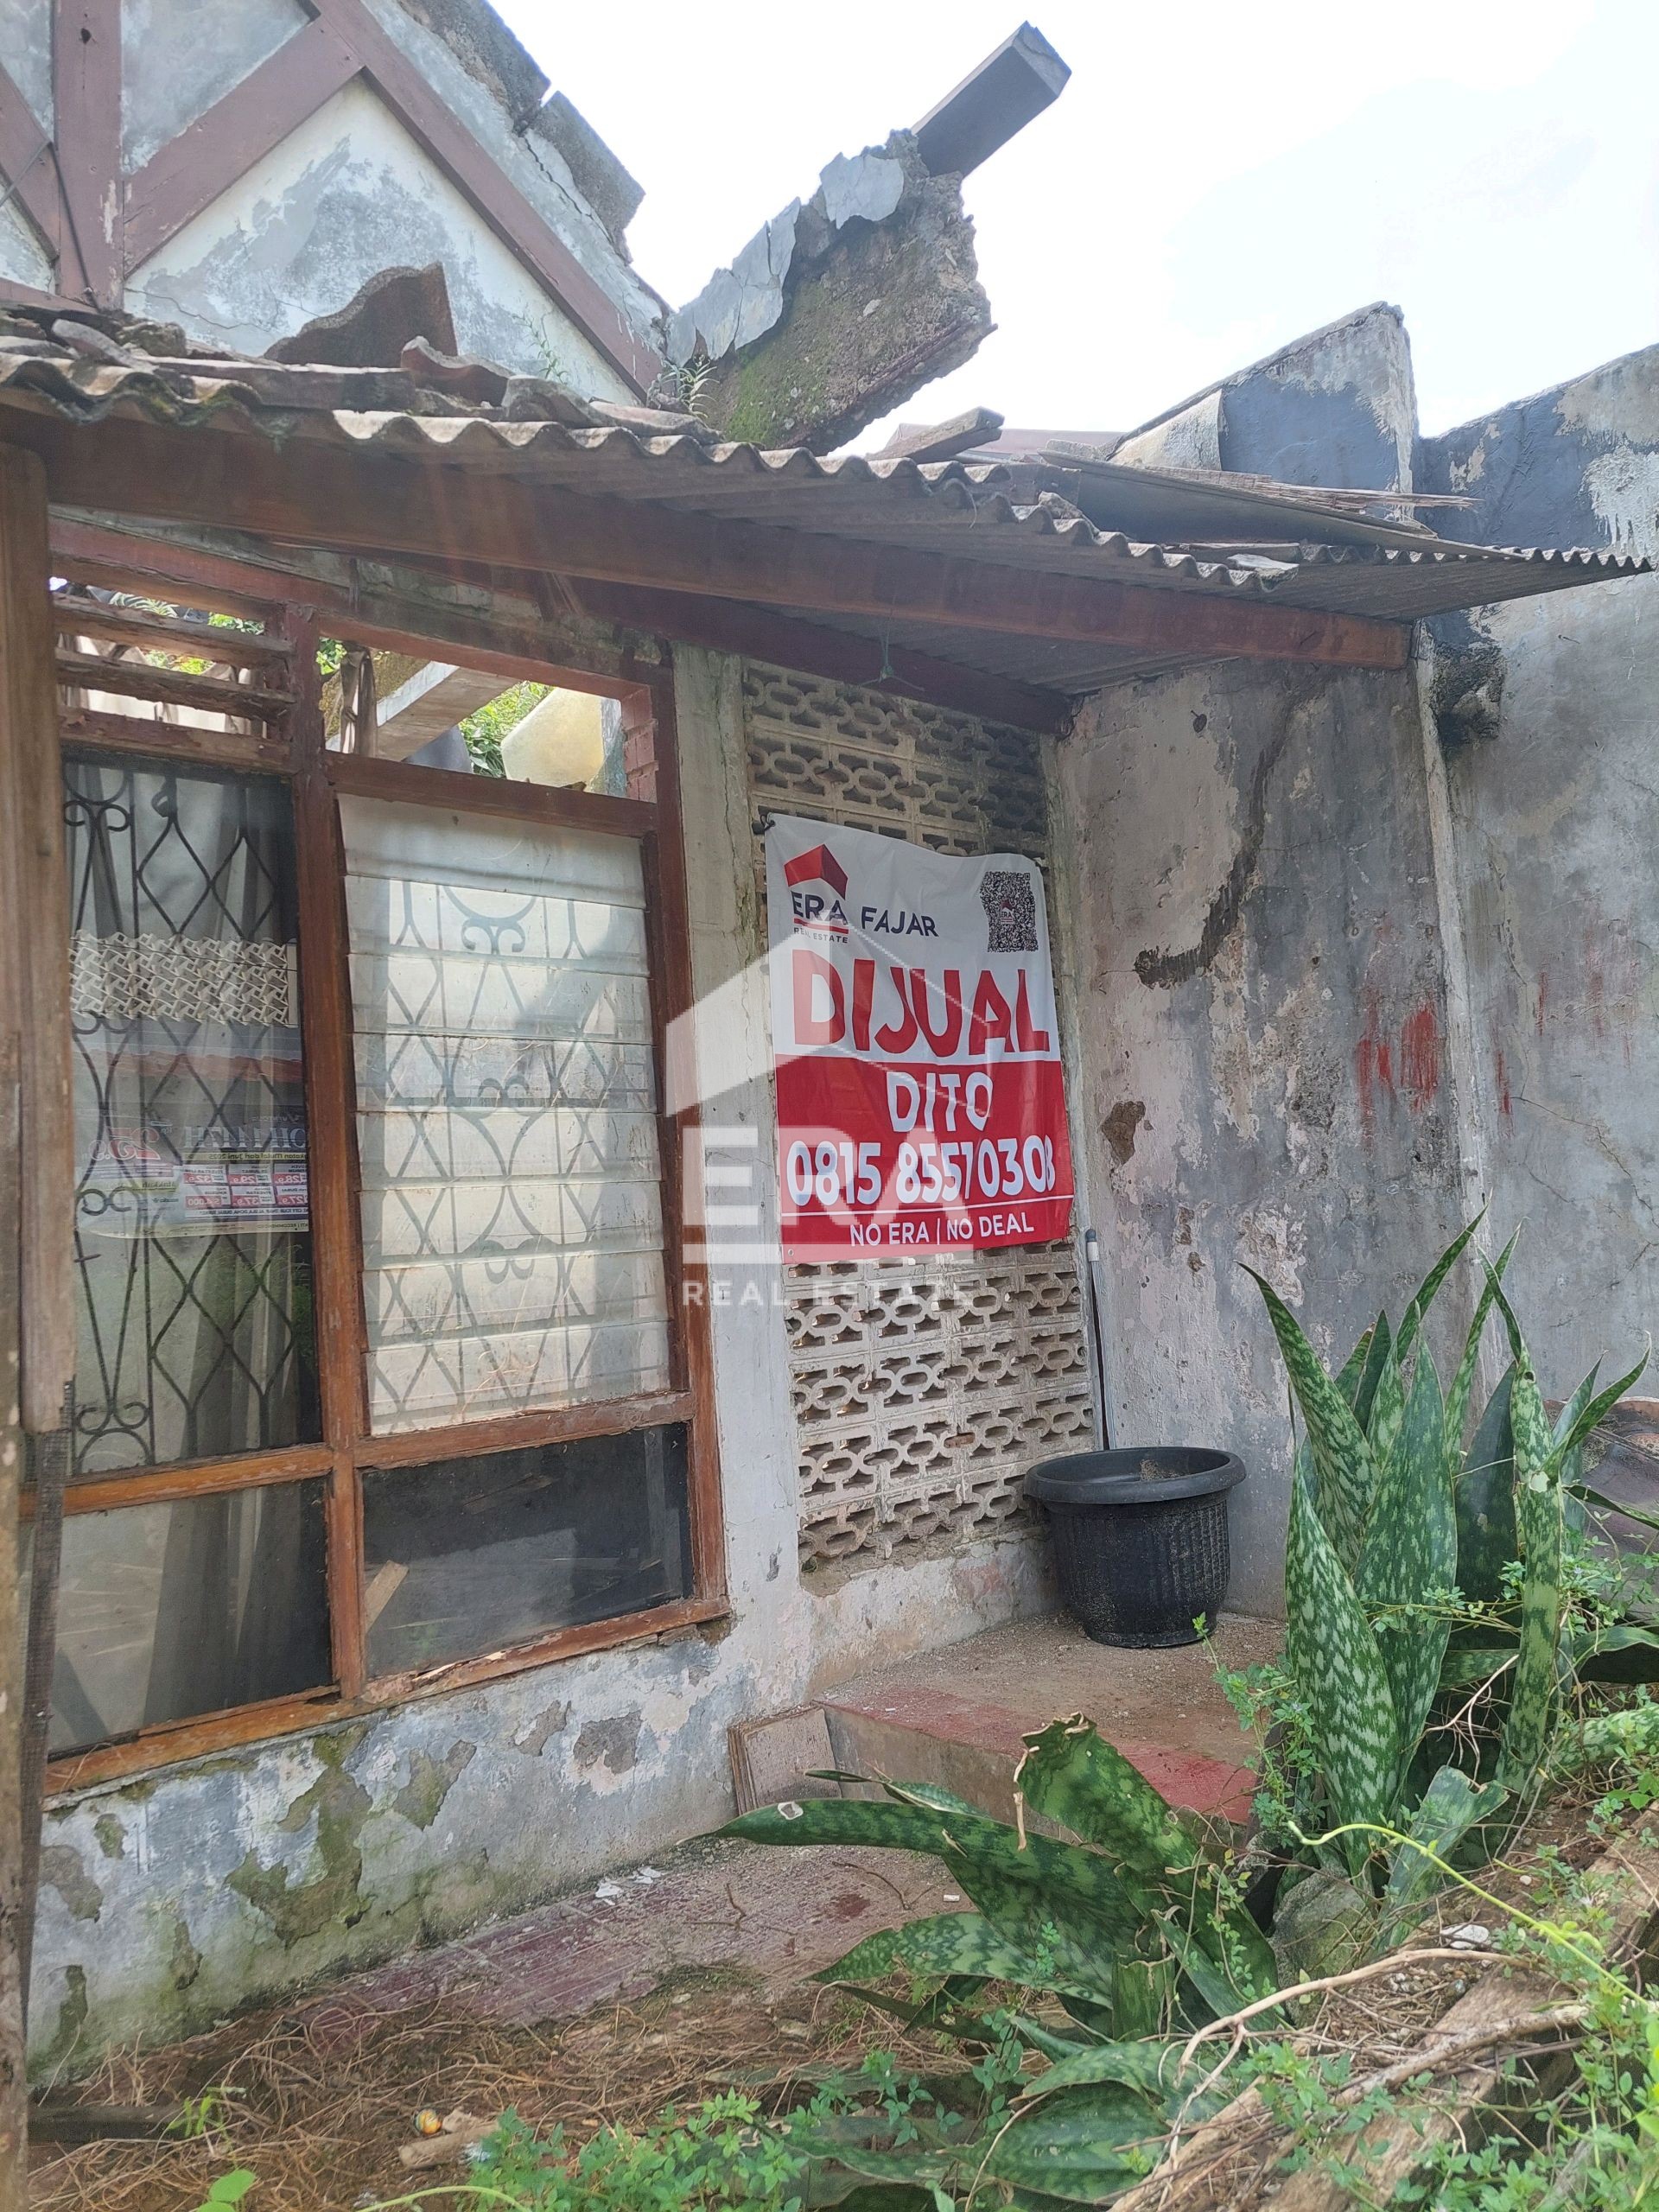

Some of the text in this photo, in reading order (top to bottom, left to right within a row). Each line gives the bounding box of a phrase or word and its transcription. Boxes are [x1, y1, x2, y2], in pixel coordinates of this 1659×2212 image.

[791, 891, 939, 938] ERA FAJAR
[793, 927, 849, 944] REAL ESTATE
[791, 949, 1051, 1058] DIJUAL
[886, 1071, 994, 1132] DITO
[786, 1140, 882, 1206] 0815
[850, 1224, 881, 1247] NO
[888, 1222, 930, 1245] ERA
[946, 1219, 974, 1242] NO
[980, 1211, 1034, 1239] DEAL
